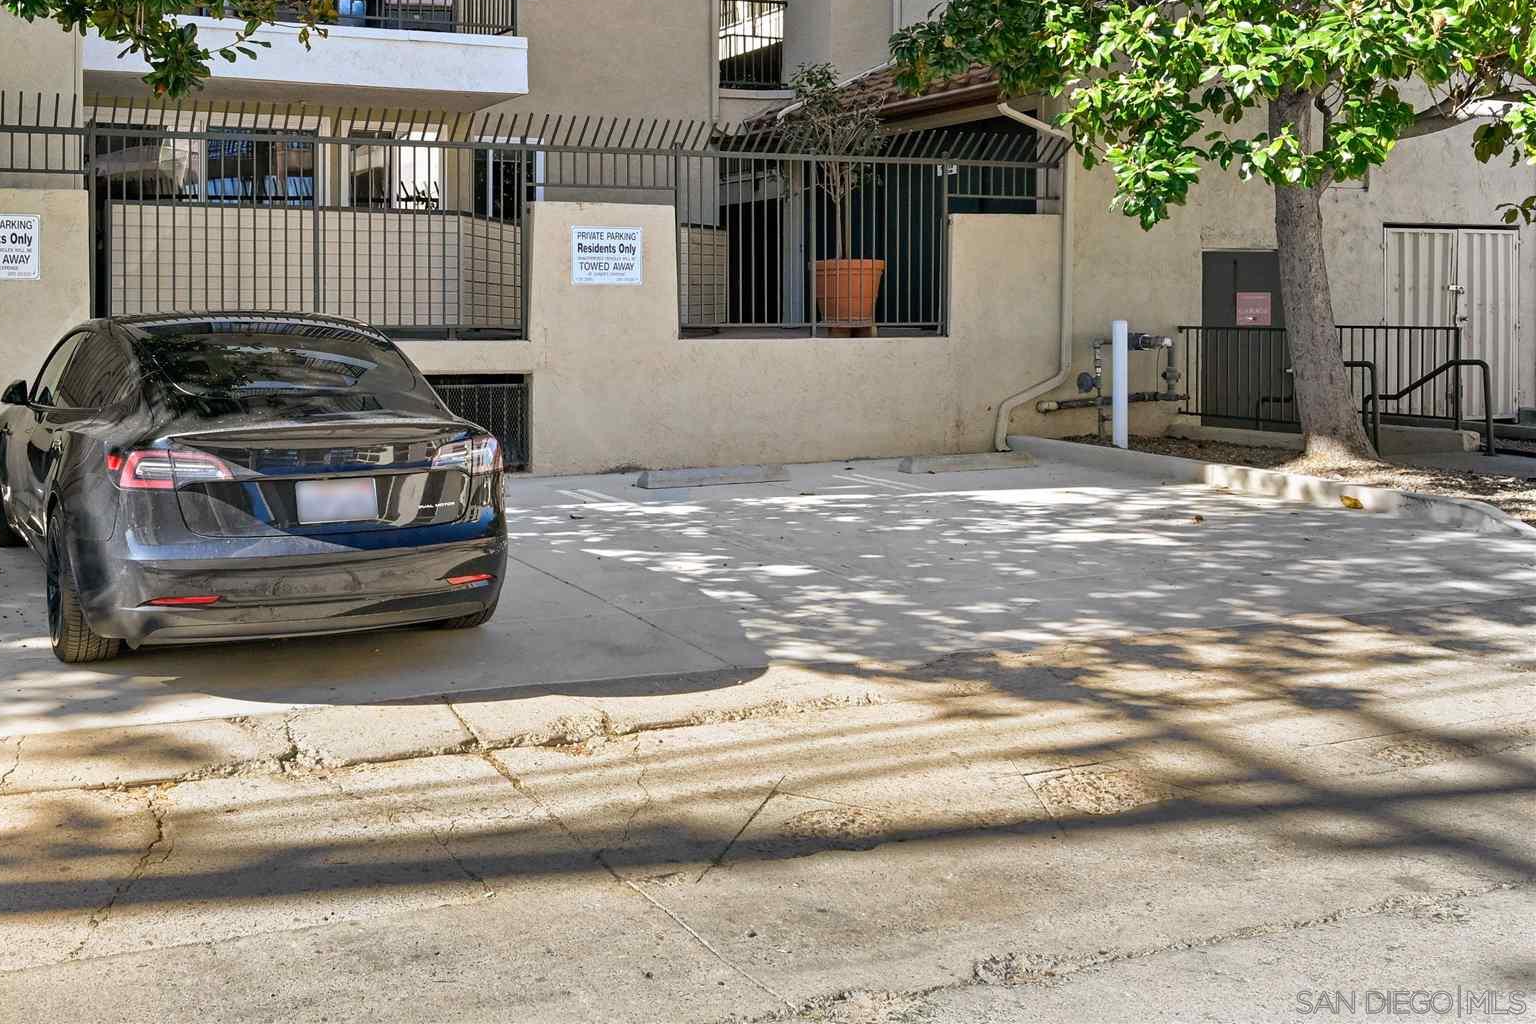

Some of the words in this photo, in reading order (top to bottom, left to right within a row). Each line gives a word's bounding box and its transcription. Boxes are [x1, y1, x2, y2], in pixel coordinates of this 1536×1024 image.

[10, 232, 33, 247] Only
[577, 231, 604, 240] PRIVATE
[606, 231, 637, 241] PARKING
[577, 242, 617, 254] Residents
[618, 243, 637, 256] Only
[2, 254, 31, 265] AWAY
[578, 261, 610, 271] TOWED
[612, 262, 635, 271] AWAY
